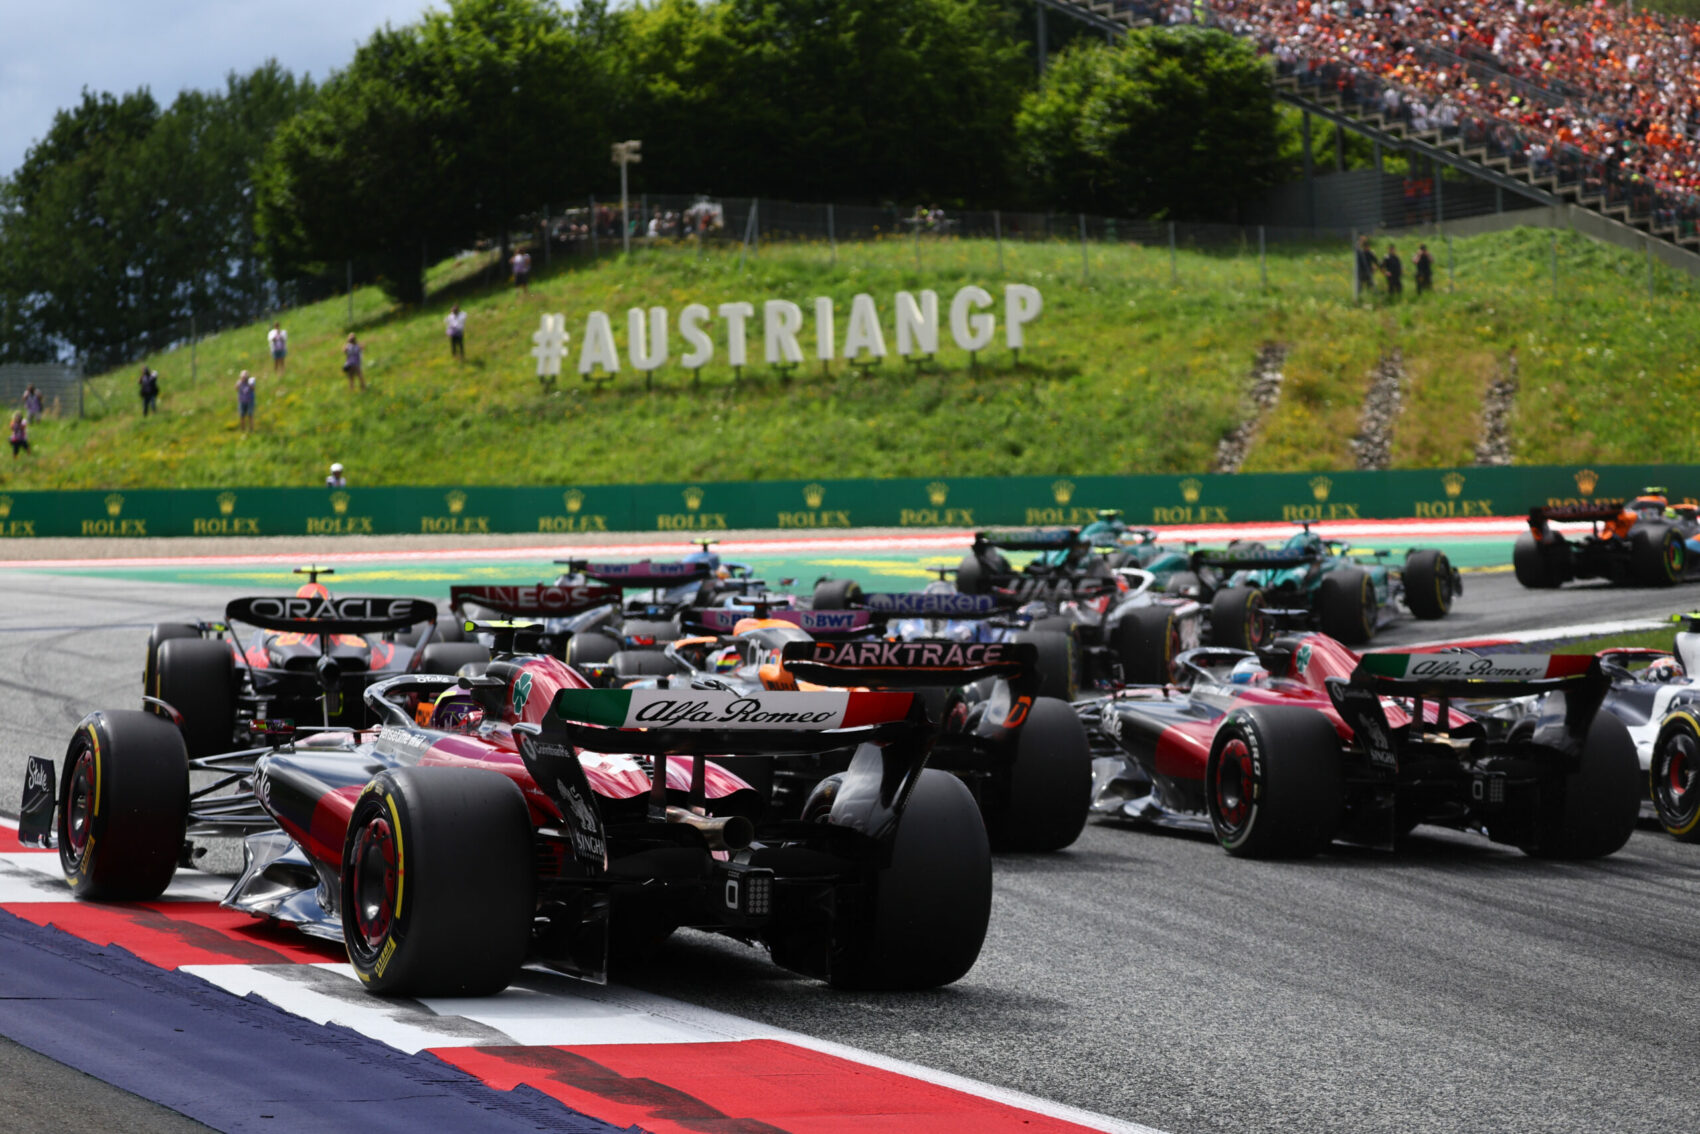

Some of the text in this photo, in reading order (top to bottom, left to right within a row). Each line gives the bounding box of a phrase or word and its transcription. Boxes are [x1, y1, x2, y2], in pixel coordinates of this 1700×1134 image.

[532, 284, 1043, 376] #AUSTRIANGP
[901, 509, 974, 527] ROLEX
[1153, 505, 1229, 524] ROLEX
[1283, 503, 1360, 522] ROLEX
[1414, 499, 1494, 519] ROLEX
[81, 520, 147, 536] ROLEX
[194, 519, 260, 536] ROLEX
[306, 518, 373, 535] ROLEX
[421, 517, 489, 534] ROLEX
[538, 516, 607, 533] ROLEX
[657, 514, 727, 531] ROLEX
[778, 511, 850, 529] ROLEX
[484, 586, 590, 608] INEOS
[250, 599, 414, 621] ORACLE
[815, 613, 856, 628] BWT
[813, 642, 1004, 665] DARKTRACE
[1411, 659, 1544, 678] Alfa Romeo
[635, 698, 838, 727] Alfa Romeo
[576, 832, 605, 855] SINGHA
